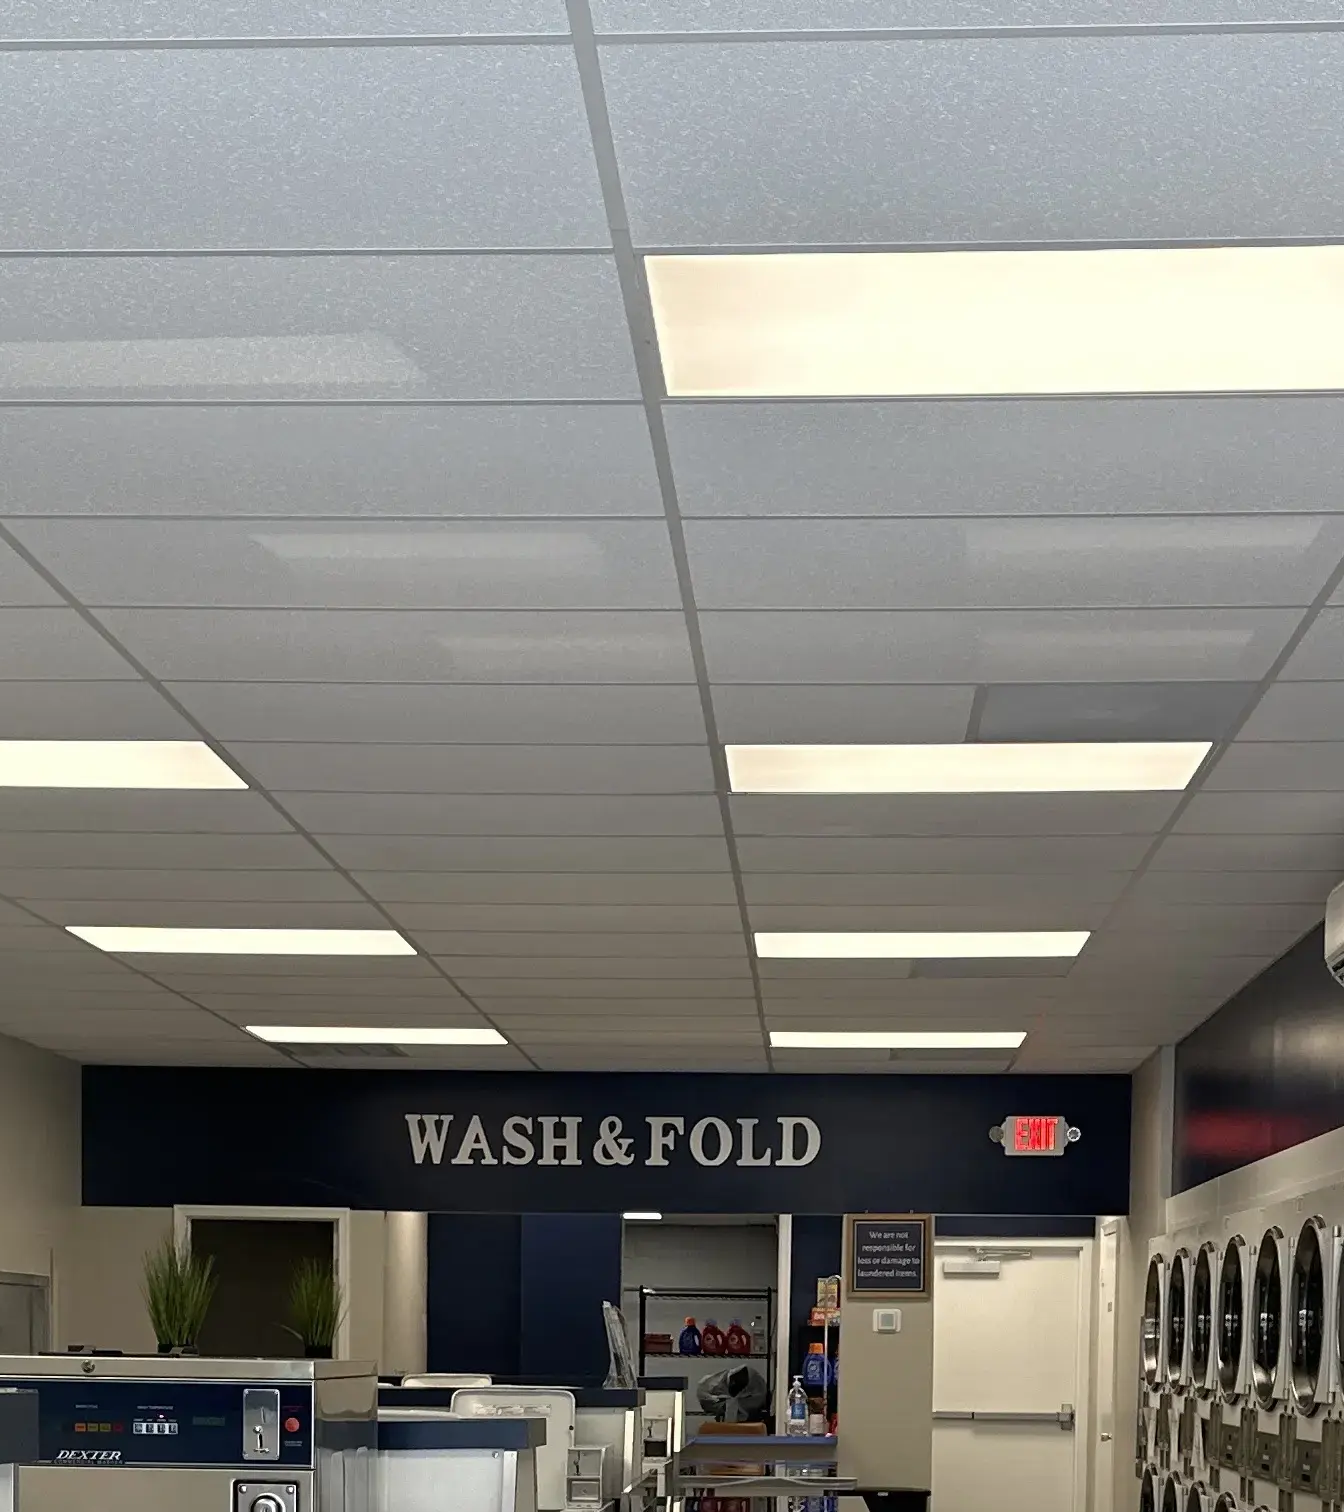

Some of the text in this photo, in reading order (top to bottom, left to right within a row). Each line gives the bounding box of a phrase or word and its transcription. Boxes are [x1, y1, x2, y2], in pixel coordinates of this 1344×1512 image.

[1016, 1118, 1058, 1150] EXIT
[405, 1114, 822, 1166] WASH & FOLD
[869, 1231, 882, 1239] We
[896, 1231, 909, 1239] not
[862, 1243, 916, 1252] responsible for
[881, 1257, 911, 1266] damage
[857, 1269, 895, 1277] laundered
[56, 1449, 122, 1460] DEXTER
